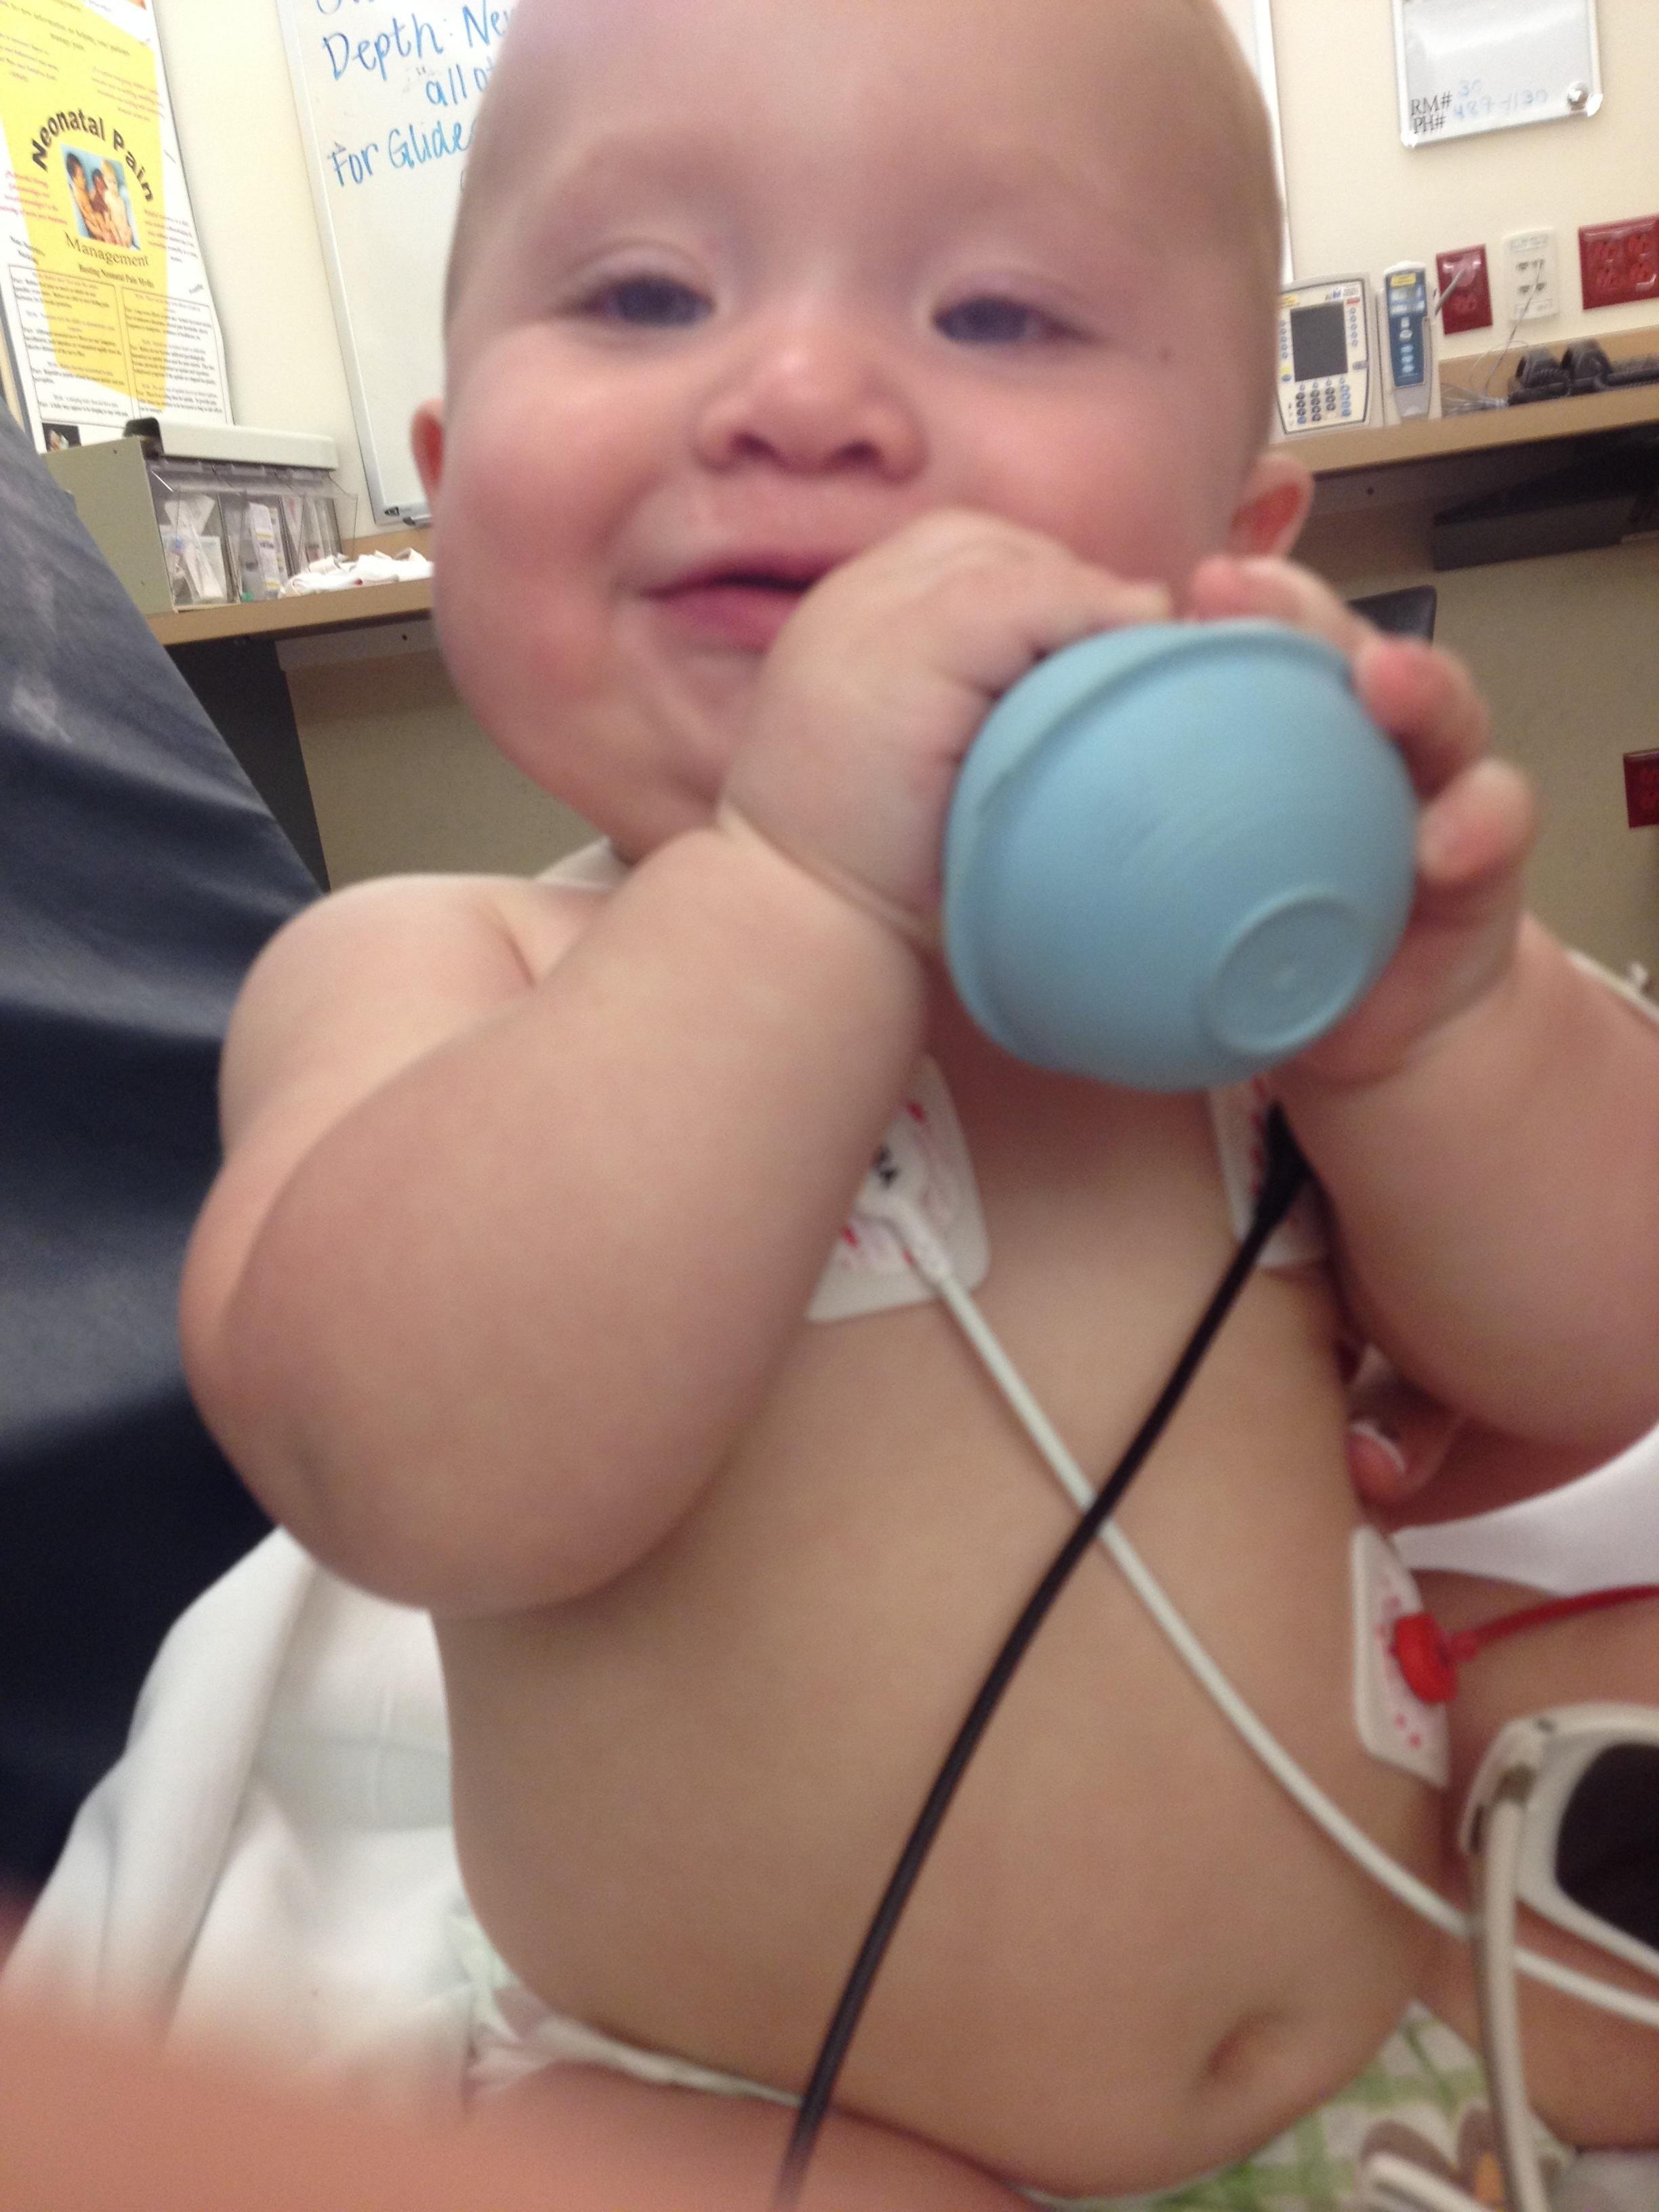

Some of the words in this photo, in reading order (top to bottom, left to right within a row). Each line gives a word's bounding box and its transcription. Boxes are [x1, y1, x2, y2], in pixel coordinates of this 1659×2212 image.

[1410, 91, 1452, 115] RM#
[1413, 113, 1446, 134] PH#
[32, 108, 106, 172] Neonatal
[112, 128, 154, 202] Pain
[327, 142, 379, 188] For
[65, 230, 150, 267] Management
